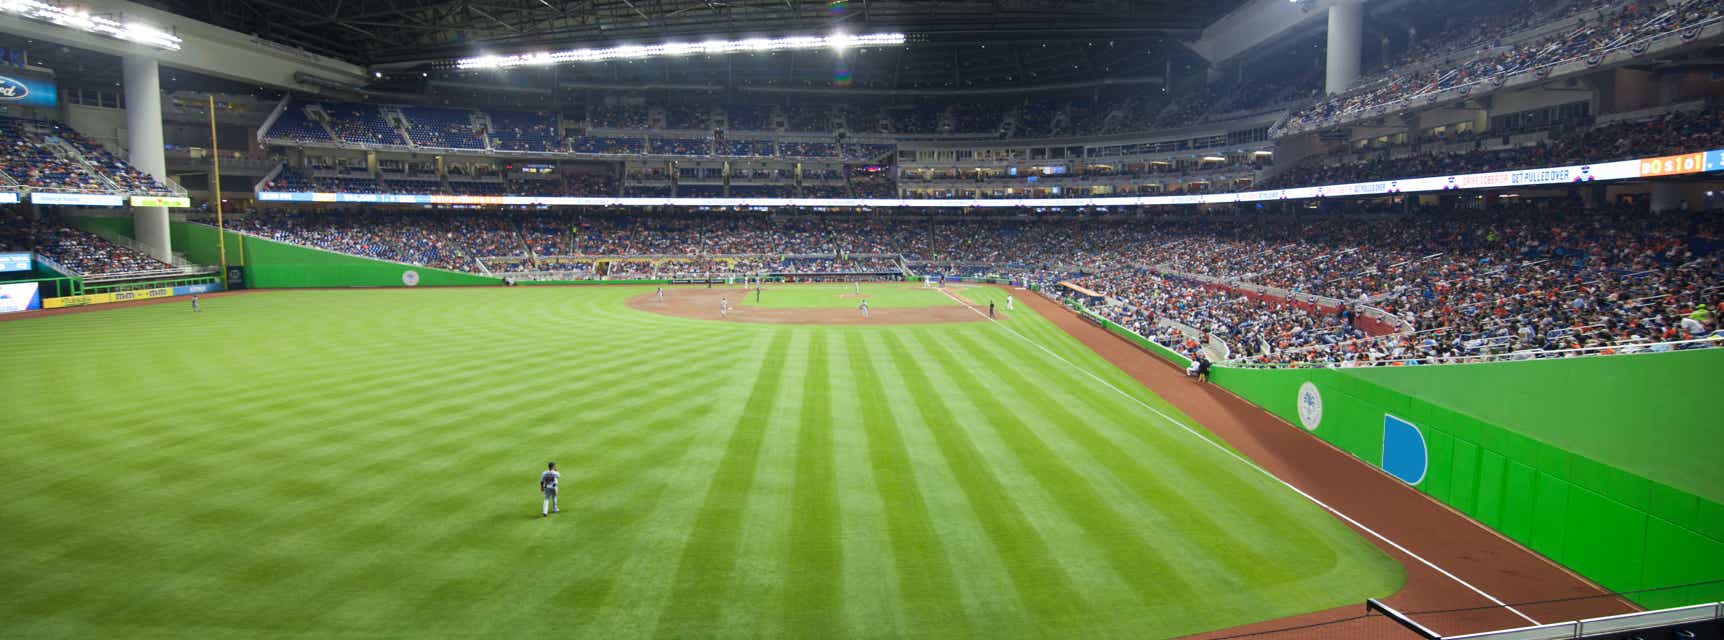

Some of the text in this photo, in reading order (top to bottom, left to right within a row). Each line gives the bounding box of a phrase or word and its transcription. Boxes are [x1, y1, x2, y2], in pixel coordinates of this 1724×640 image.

[1511, 173, 1523, 184] GET
[1524, 171, 1549, 182] PULLED
[1550, 169, 1569, 181] OVER
